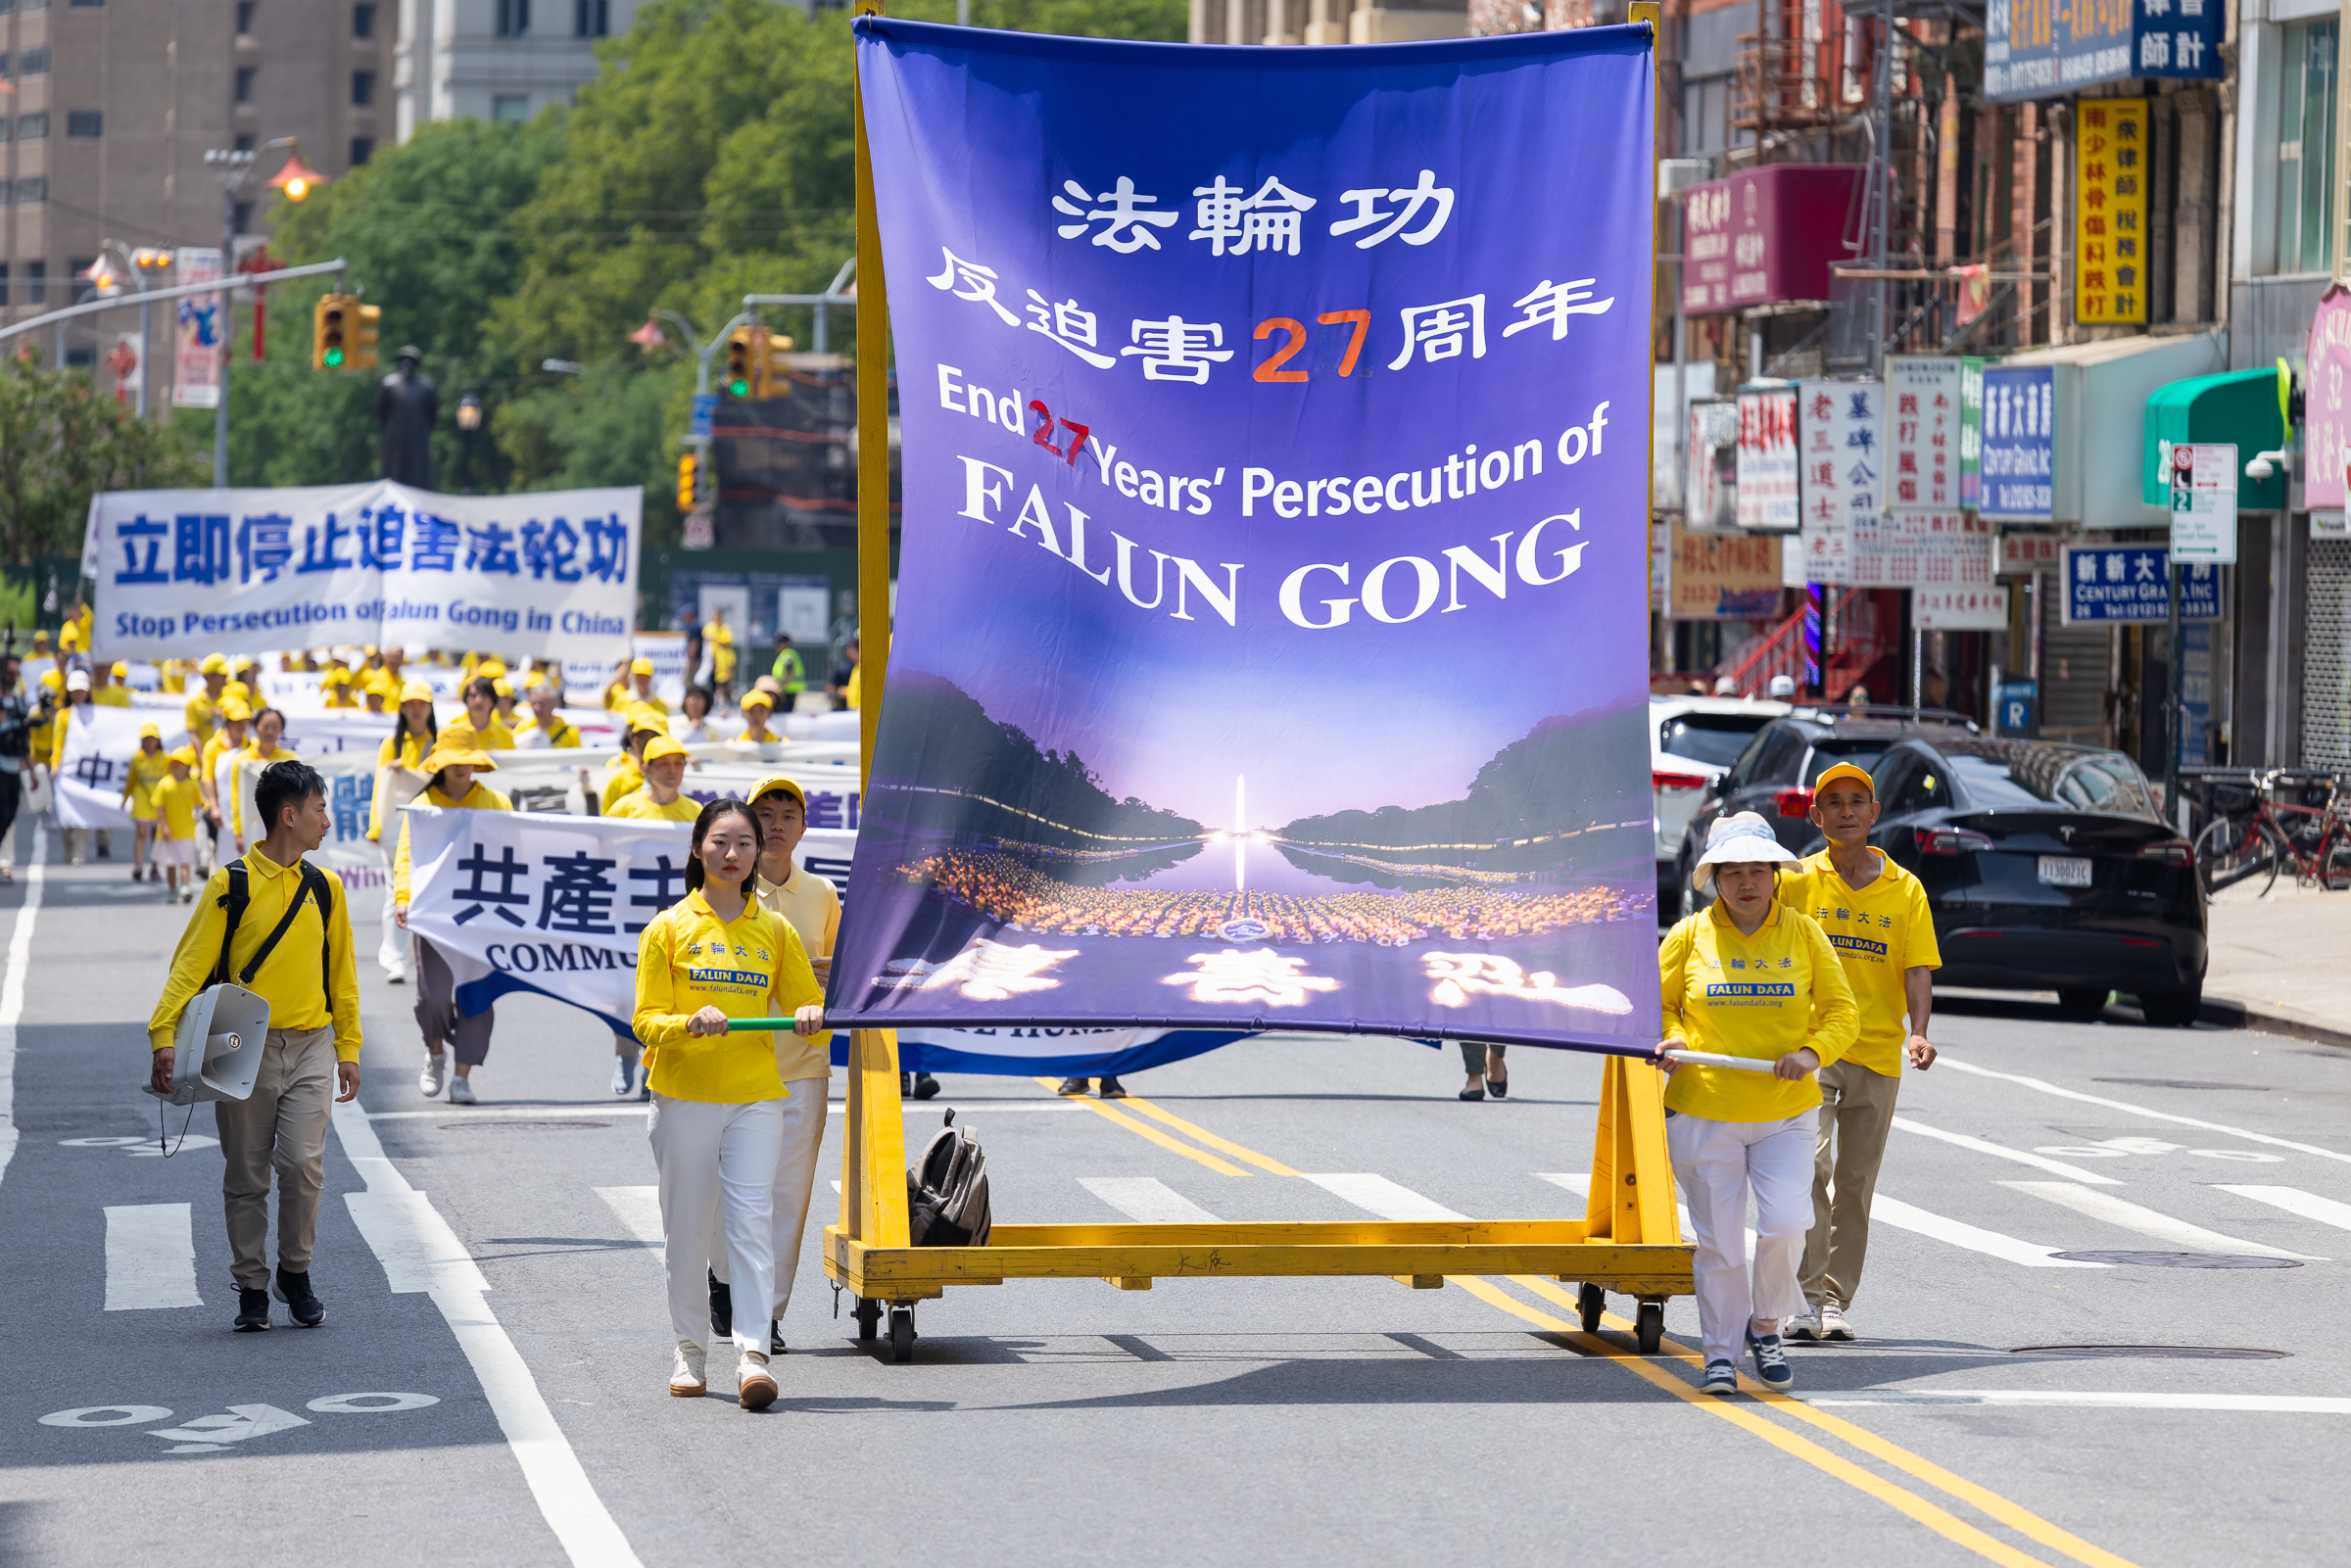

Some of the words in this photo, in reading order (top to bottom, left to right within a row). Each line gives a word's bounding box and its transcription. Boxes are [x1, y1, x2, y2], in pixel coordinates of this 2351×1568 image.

[1051, 169, 1455, 257] 法輪功
[926, 246, 1615, 385] 反迫害27周年
[937, 363, 1025, 436] End
[1029, 400, 1089, 467] 27
[1242, 443, 1543, 518] Persecution
[1558, 401, 1610, 465] of
[115, 503, 628, 587] 立即停止迫害法轮功
[956, 454, 1244, 627] FALUN
[1278, 507, 1590, 629] GONG
[2138, 582, 2189, 601] GRAD,
[115, 611, 175, 640] Stop
[183, 599, 347, 635] Persecution
[449, 599, 519, 635] Gong
[528, 607, 552, 632] in
[561, 610, 625, 636] China
[1816, 907, 1893, 928] 法輪大法
[687, 942, 769, 961] 法輪大法
[1832, 936, 1853, 948] LUN
[1856, 939, 1884, 953] DAFA
[1707, 958, 1792, 970] 法輪大法
[693, 970, 732, 981] FALUN
[736, 973, 767, 985] DAFA
[689, 984, 758, 997] www.falundafa.org
[1709, 985, 1752, 995] FALUN
[1757, 984, 1792, 995] DAFA
[1707, 998, 1783, 1008] www.falundafa.org
